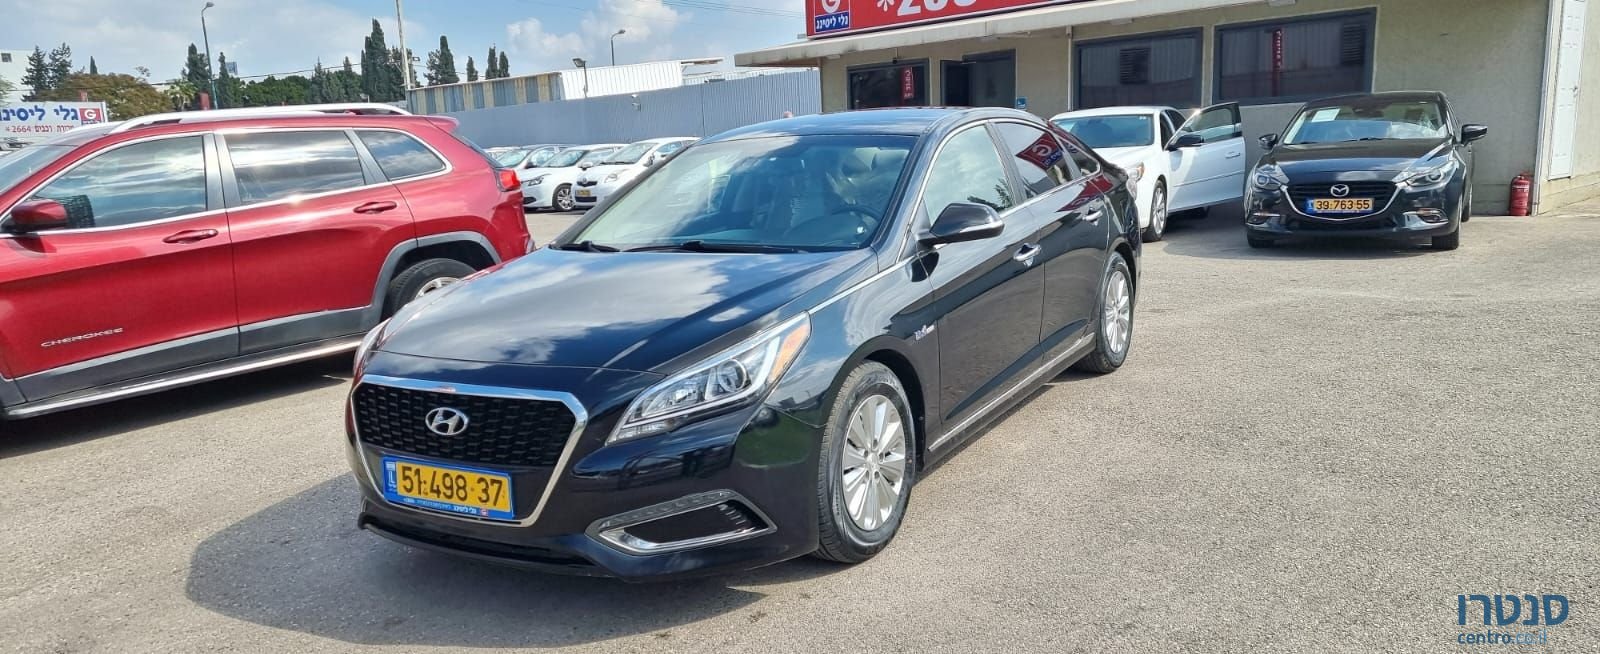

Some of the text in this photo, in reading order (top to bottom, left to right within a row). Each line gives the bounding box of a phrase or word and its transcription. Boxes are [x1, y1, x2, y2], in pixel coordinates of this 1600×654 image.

[838, 14, 849, 26] גלי
[0, 104, 79, 121] גלי ליסינ
[41, 327, 124, 347] CHEROKEE
